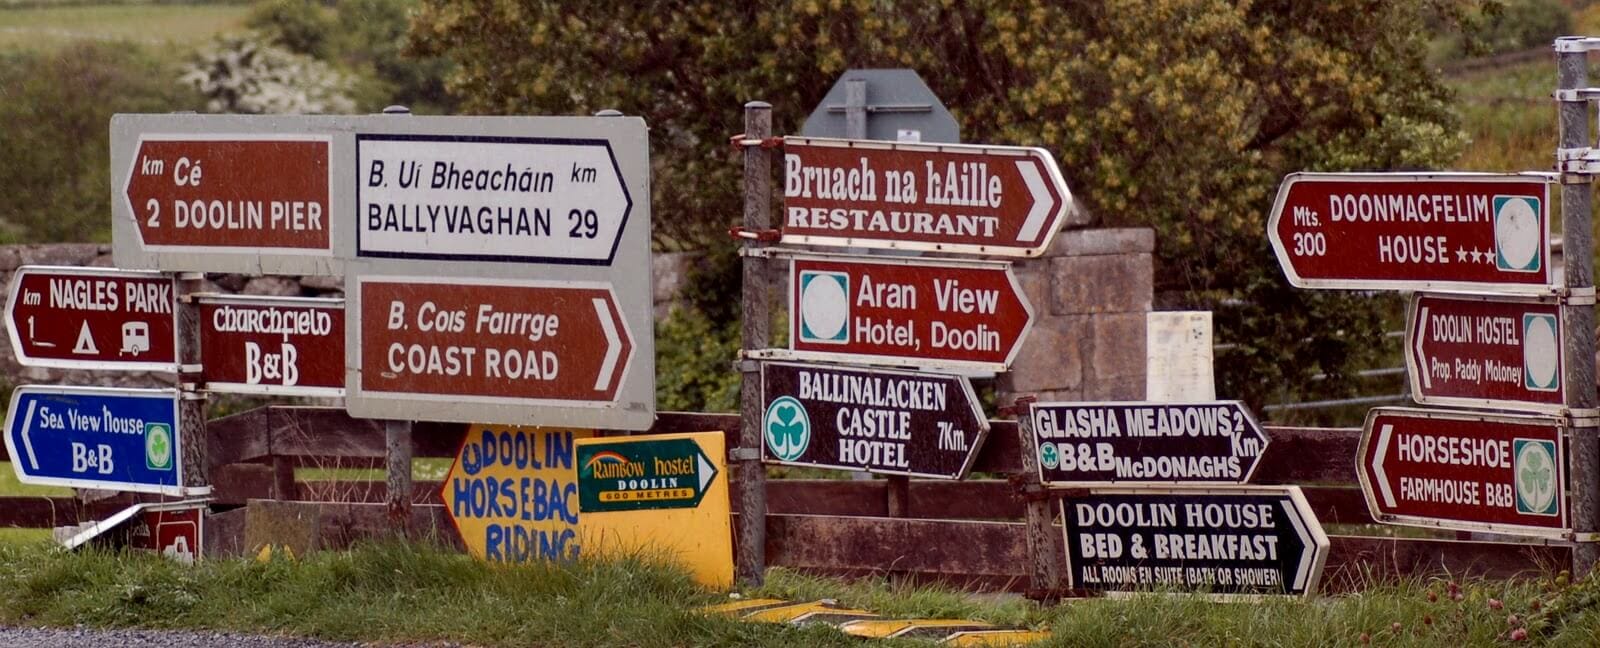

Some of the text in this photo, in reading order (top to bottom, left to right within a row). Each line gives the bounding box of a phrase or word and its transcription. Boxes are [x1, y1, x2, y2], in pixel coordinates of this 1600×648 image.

[141, 156, 202, 186] km Cé
[368, 160, 597, 193] B. Uí Bheacháin km
[784, 153, 1002, 208] Bruach na hAille
[147, 199, 322, 231] 2 DOOLIN PIER
[368, 204, 599, 239] BALLYVAGHAN 29
[787, 206, 999, 237] RESTAURANT
[1293, 206, 1322, 227] Mts.
[1329, 194, 1490, 223] DOONMACFELIM
[1293, 232, 1326, 257] 300
[1378, 235, 1450, 264] HOUSE
[23, 278, 171, 314] km NAGLES PARK
[857, 274, 999, 315] Aran View
[388, 301, 559, 342] B. Cois Fairrge
[855, 317, 1000, 352] Hotel, Doolin
[1432, 315, 1520, 346] DOOLIN HOSTEL
[245, 341, 299, 386] B&B
[388, 342, 559, 380] COAST ROAD
[1431, 356, 1522, 387] Prop. Paddy Moloney
[799, 371, 946, 411] BALLINALACKEN
[40, 406, 65, 430] Sea
[68, 407, 101, 433] View
[836, 407, 912, 440] CASTLE
[1036, 407, 1245, 438] GLASHA MEADOWS 2
[72, 442, 114, 474] B&B
[482, 430, 573, 470] DOOLIN
[839, 439, 909, 468] HOTEL
[1058, 443, 1241, 478] B&B McDONAGHS
[1398, 433, 1512, 469] HORSESHOE
[606, 490, 688, 500] 600 METRES
[618, 478, 678, 490] DOOLIN
[1400, 476, 1514, 508] FARMHOUSE B&B
[453, 476, 579, 525] HORSEBAC
[1076, 503, 1275, 529] DOOLIN HOUSE
[486, 523, 580, 565] RIDING
[1080, 533, 1278, 561] BED & BREAKFAST
[1082, 566, 1100, 583] ALL
[1102, 566, 1137, 585] ROOMS
[1139, 567, 1152, 585] EN
[1155, 567, 1184, 585] SUITE
[1218, 568, 1233, 585] OR
